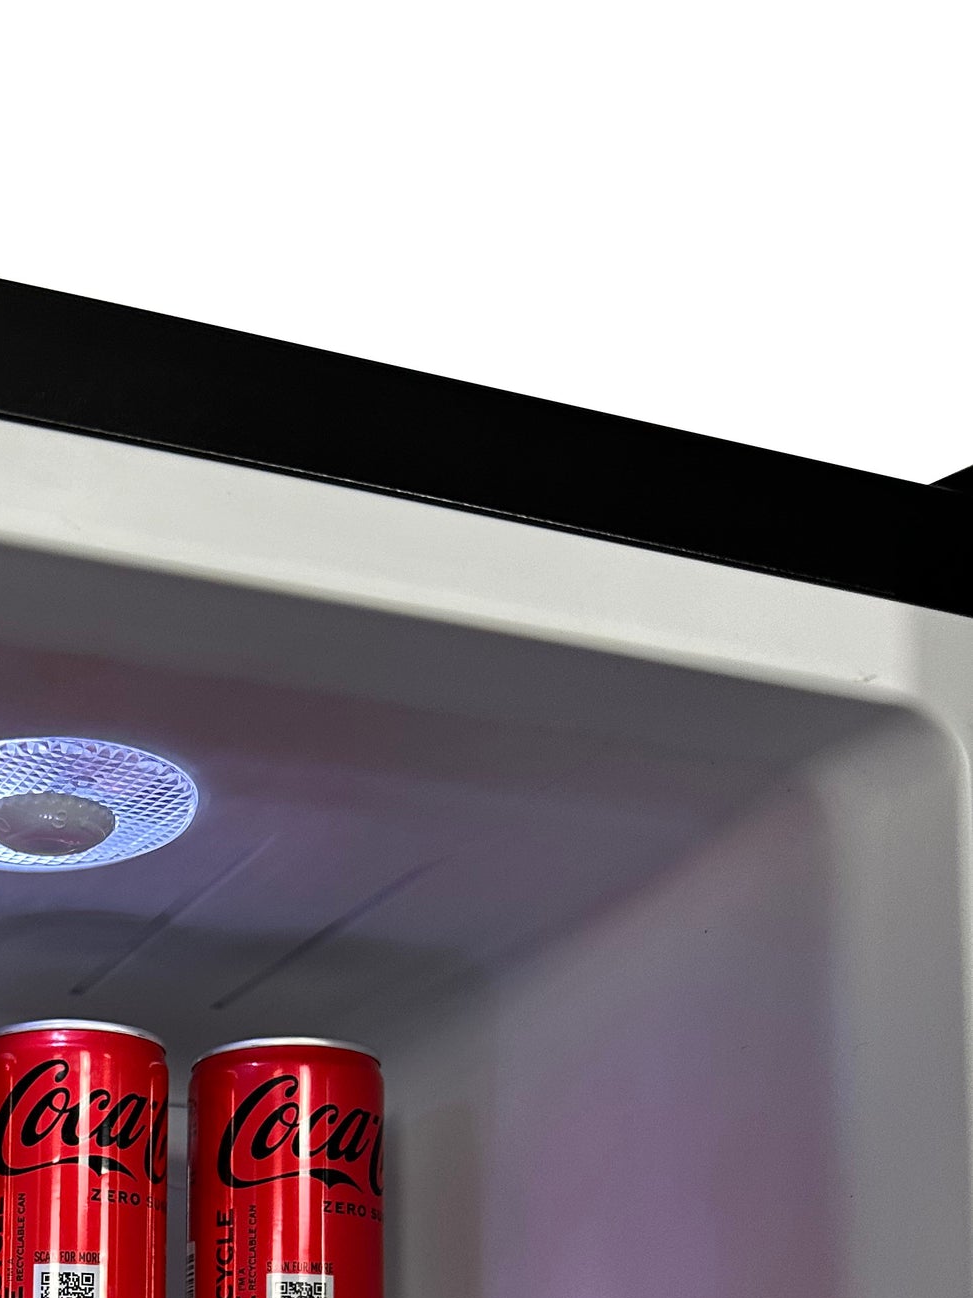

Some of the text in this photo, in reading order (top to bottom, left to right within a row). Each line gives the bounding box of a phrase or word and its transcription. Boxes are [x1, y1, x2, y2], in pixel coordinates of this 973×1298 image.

[90, 1187, 141, 1206] ZERO
[323, 1200, 367, 1217] ZERO
[15, 1192, 27, 1282] RECYCLABLE CAN
[33, 1250, 57, 1263] SCA
[60, 1250, 76, 1263] FOR
[248, 1204, 258, 1291] RECYCLABLE CAN
[266, 1261, 290, 1273] SAN
[310, 1262, 334, 1274] MORE
